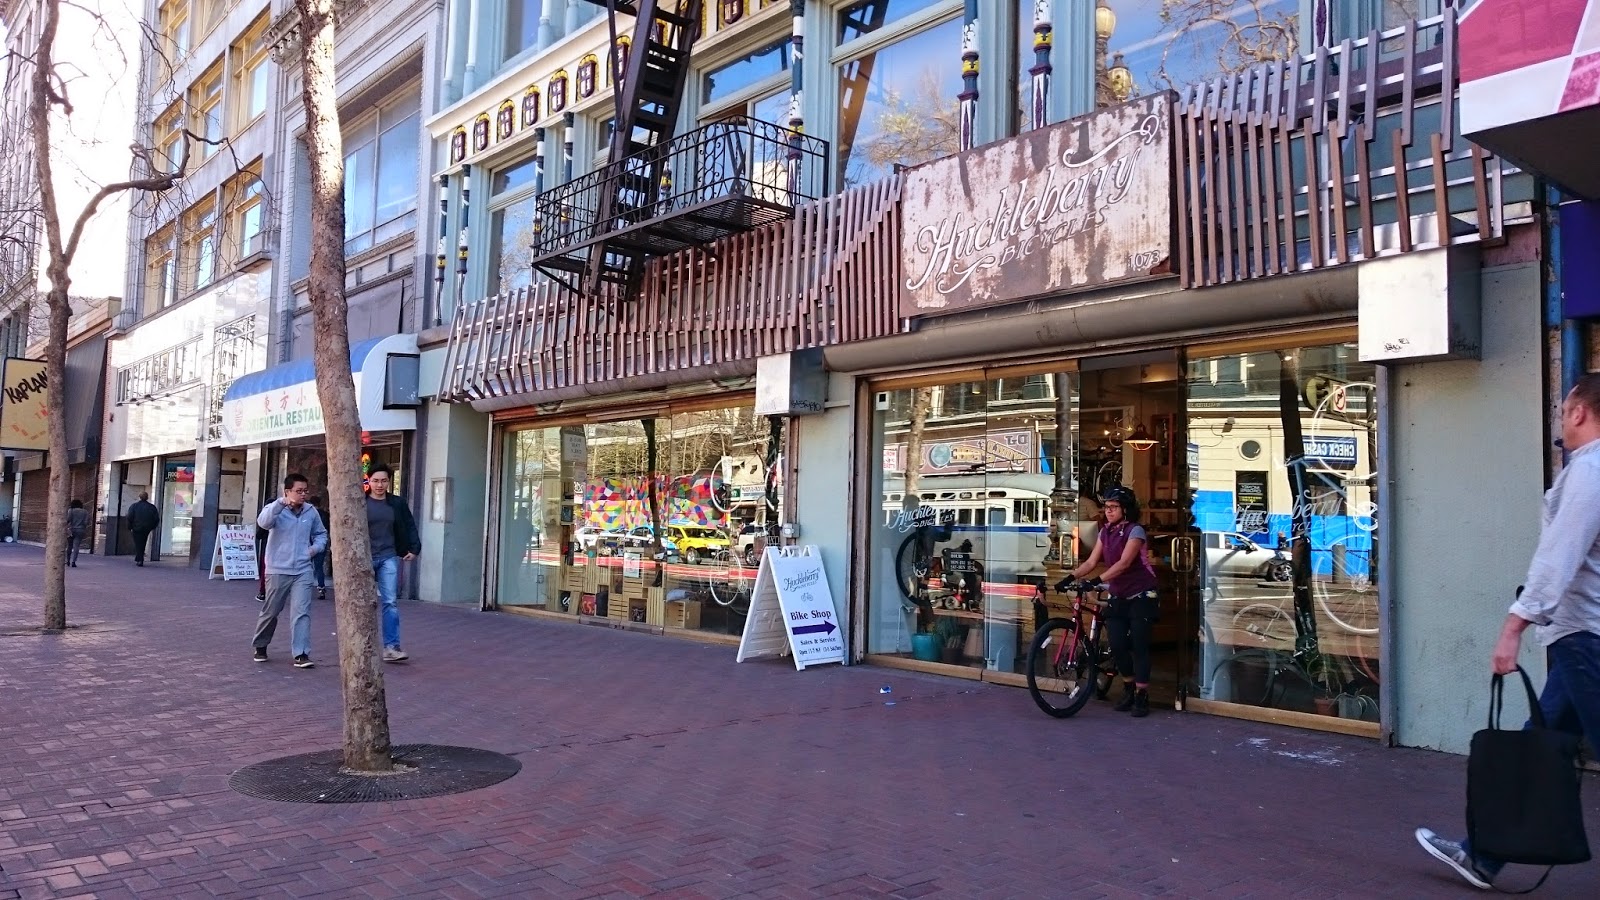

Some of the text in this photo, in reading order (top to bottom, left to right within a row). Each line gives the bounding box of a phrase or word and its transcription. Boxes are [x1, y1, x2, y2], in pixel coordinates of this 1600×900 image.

[906, 140, 1144, 293] Huckleberry
[1000, 205, 1109, 267] BICYCLES
[1128, 250, 1161, 271] 1073
[248, 413, 286, 433] ORIENTAL
[790, 609, 832, 621] Bike Shop
